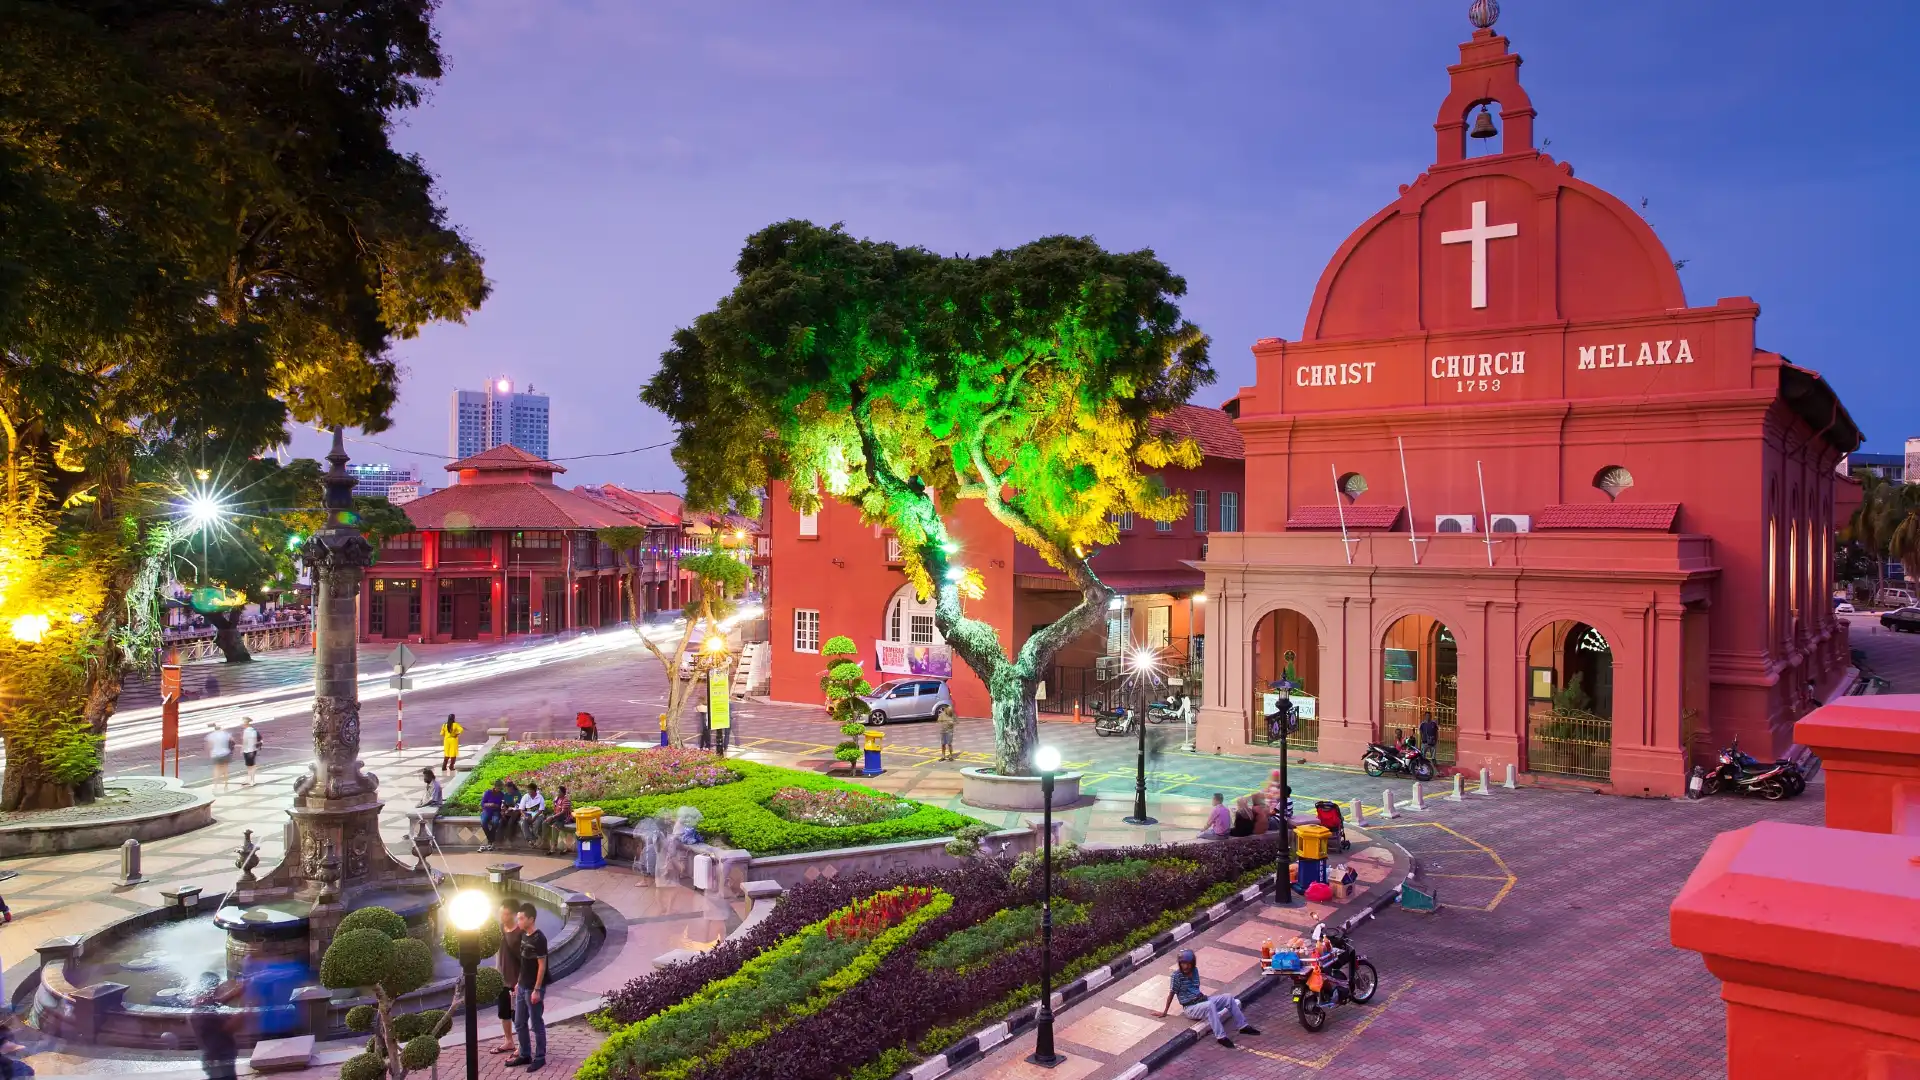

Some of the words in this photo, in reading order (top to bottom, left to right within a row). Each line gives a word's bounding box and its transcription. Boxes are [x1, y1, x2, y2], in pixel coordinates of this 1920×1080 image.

[1296, 361, 1376, 387] CHRIST
[1431, 351, 1526, 379] CHURCH
[1577, 339, 1694, 370] MELAKA
[1456, 379, 1501, 393] 1753
